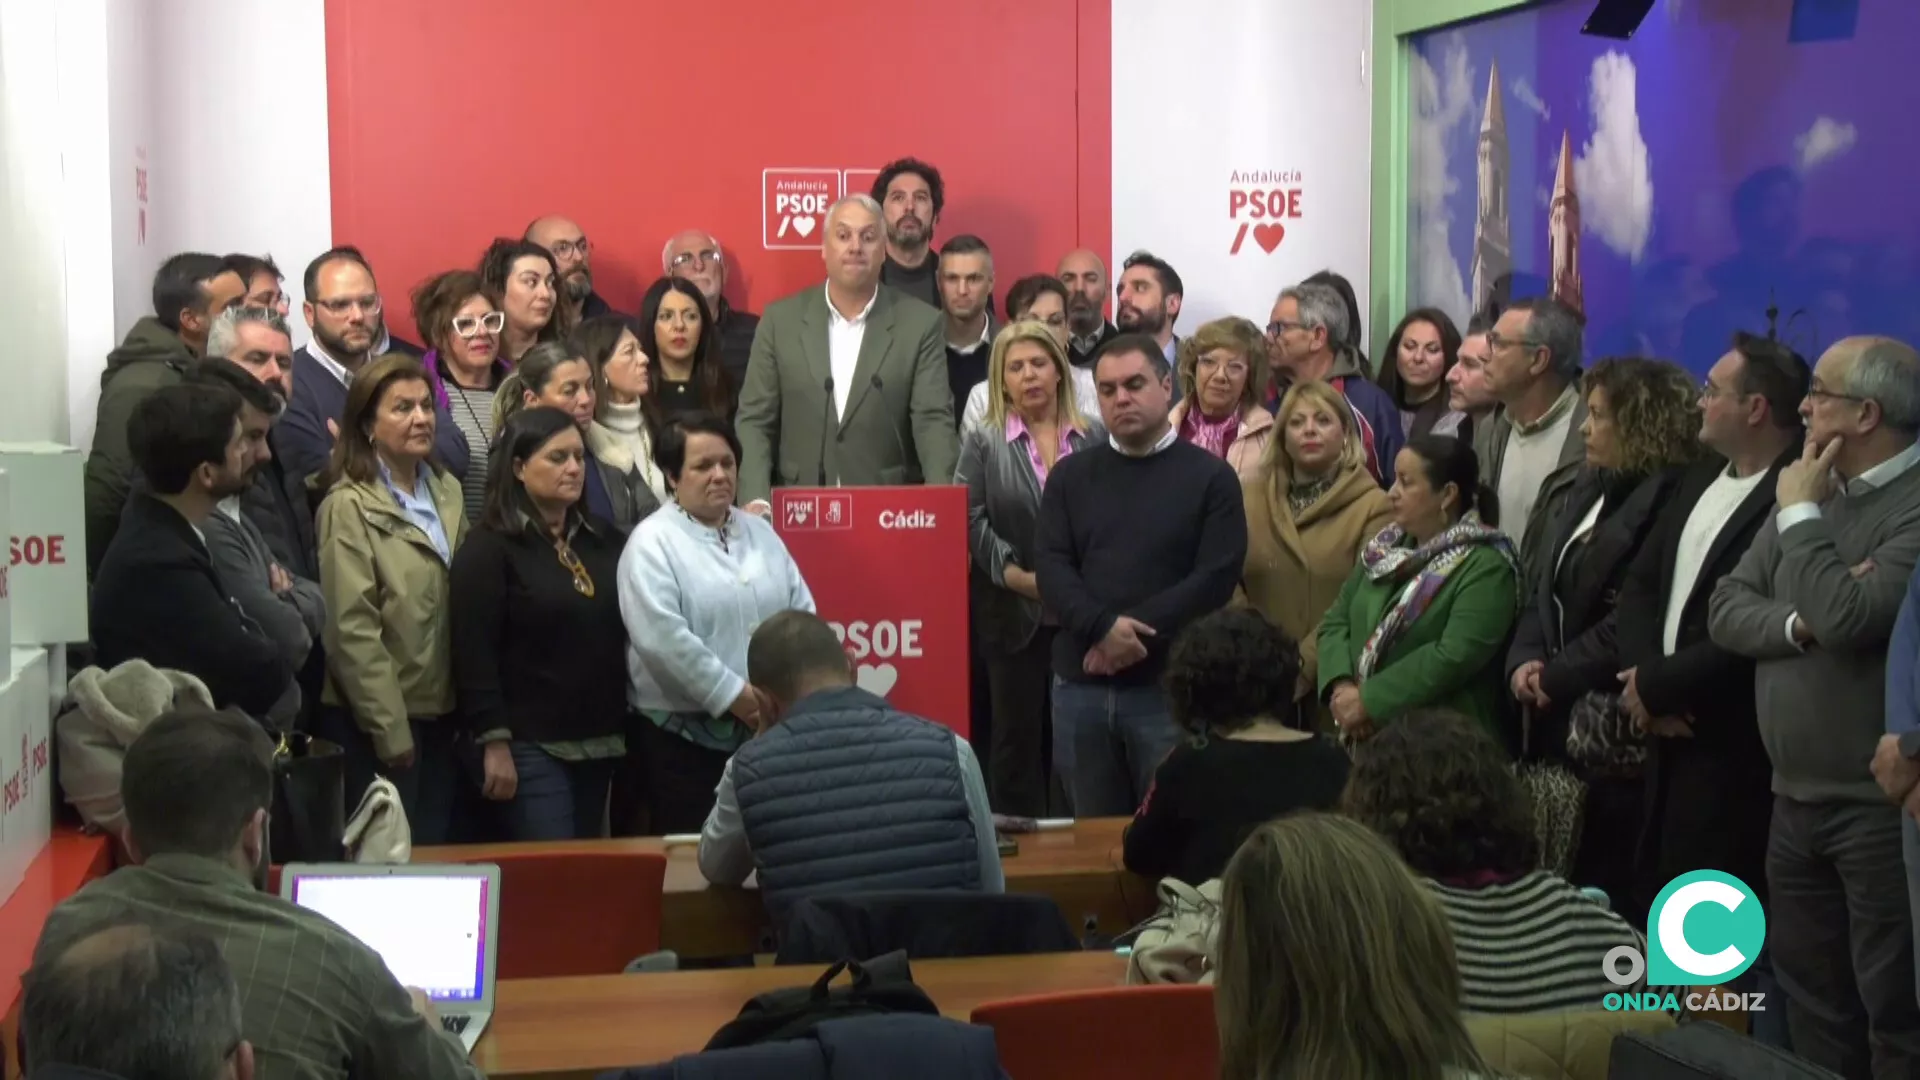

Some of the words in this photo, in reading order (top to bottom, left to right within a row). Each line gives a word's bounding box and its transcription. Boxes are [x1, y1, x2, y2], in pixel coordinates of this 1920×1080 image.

[776, 180, 828, 191] Andalucía
[1230, 167, 1302, 184] Andalucía
[776, 193, 828, 214] PSOE
[1230, 189, 1302, 219] PSOE
[786, 501, 813, 513] PSOE
[879, 509, 936, 530] Cádiz
[10, 535, 66, 565] SOE
[33, 735, 47, 777] PSOE
[4, 766, 20, 816] PSOE
